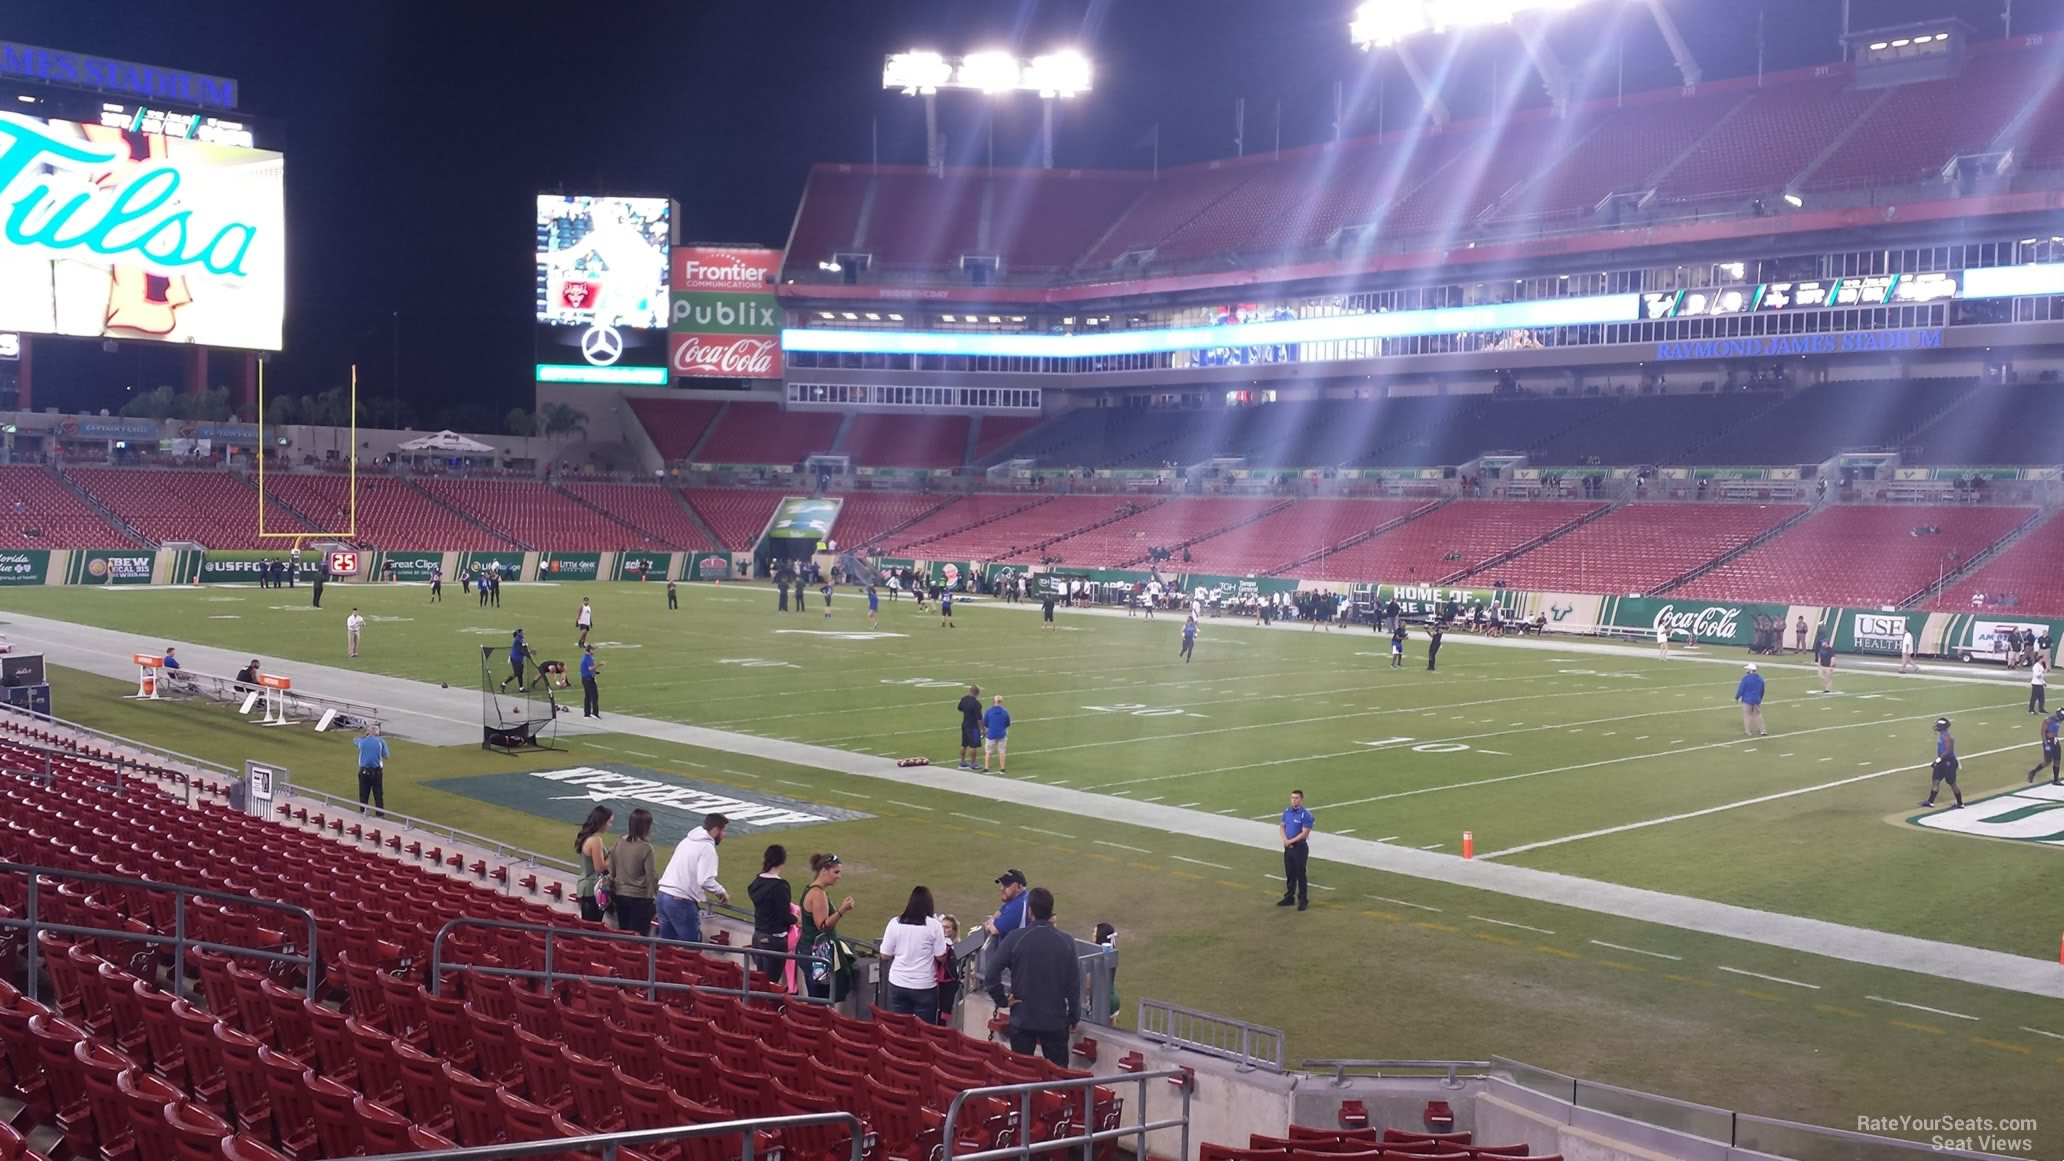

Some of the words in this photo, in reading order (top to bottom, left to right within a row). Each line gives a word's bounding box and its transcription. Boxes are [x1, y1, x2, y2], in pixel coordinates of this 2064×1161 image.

[84, 56, 233, 108] STADIUM
[0, 117, 257, 278] Tulsa
[686, 260, 767, 281] Frontier
[686, 280, 763, 289] COMMUNICATIONS
[672, 300, 775, 327] Publix
[1657, 337, 1761, 361] RAYMOND
[1766, 334, 1836, 356] JAMES
[1841, 328, 1942, 351] STADIUM
[674, 338, 778, 373] Coca-Cola
[333, 554, 354, 571] 25
[414, 559, 439, 570] Clips
[1393, 586, 1443, 602] HOME
[1448, 589, 1473, 604] OF
[1653, 603, 1742, 639] Coca-Cola
[1859, 617, 1906, 636] USF
[1854, 638, 1904, 650] HEALTH
